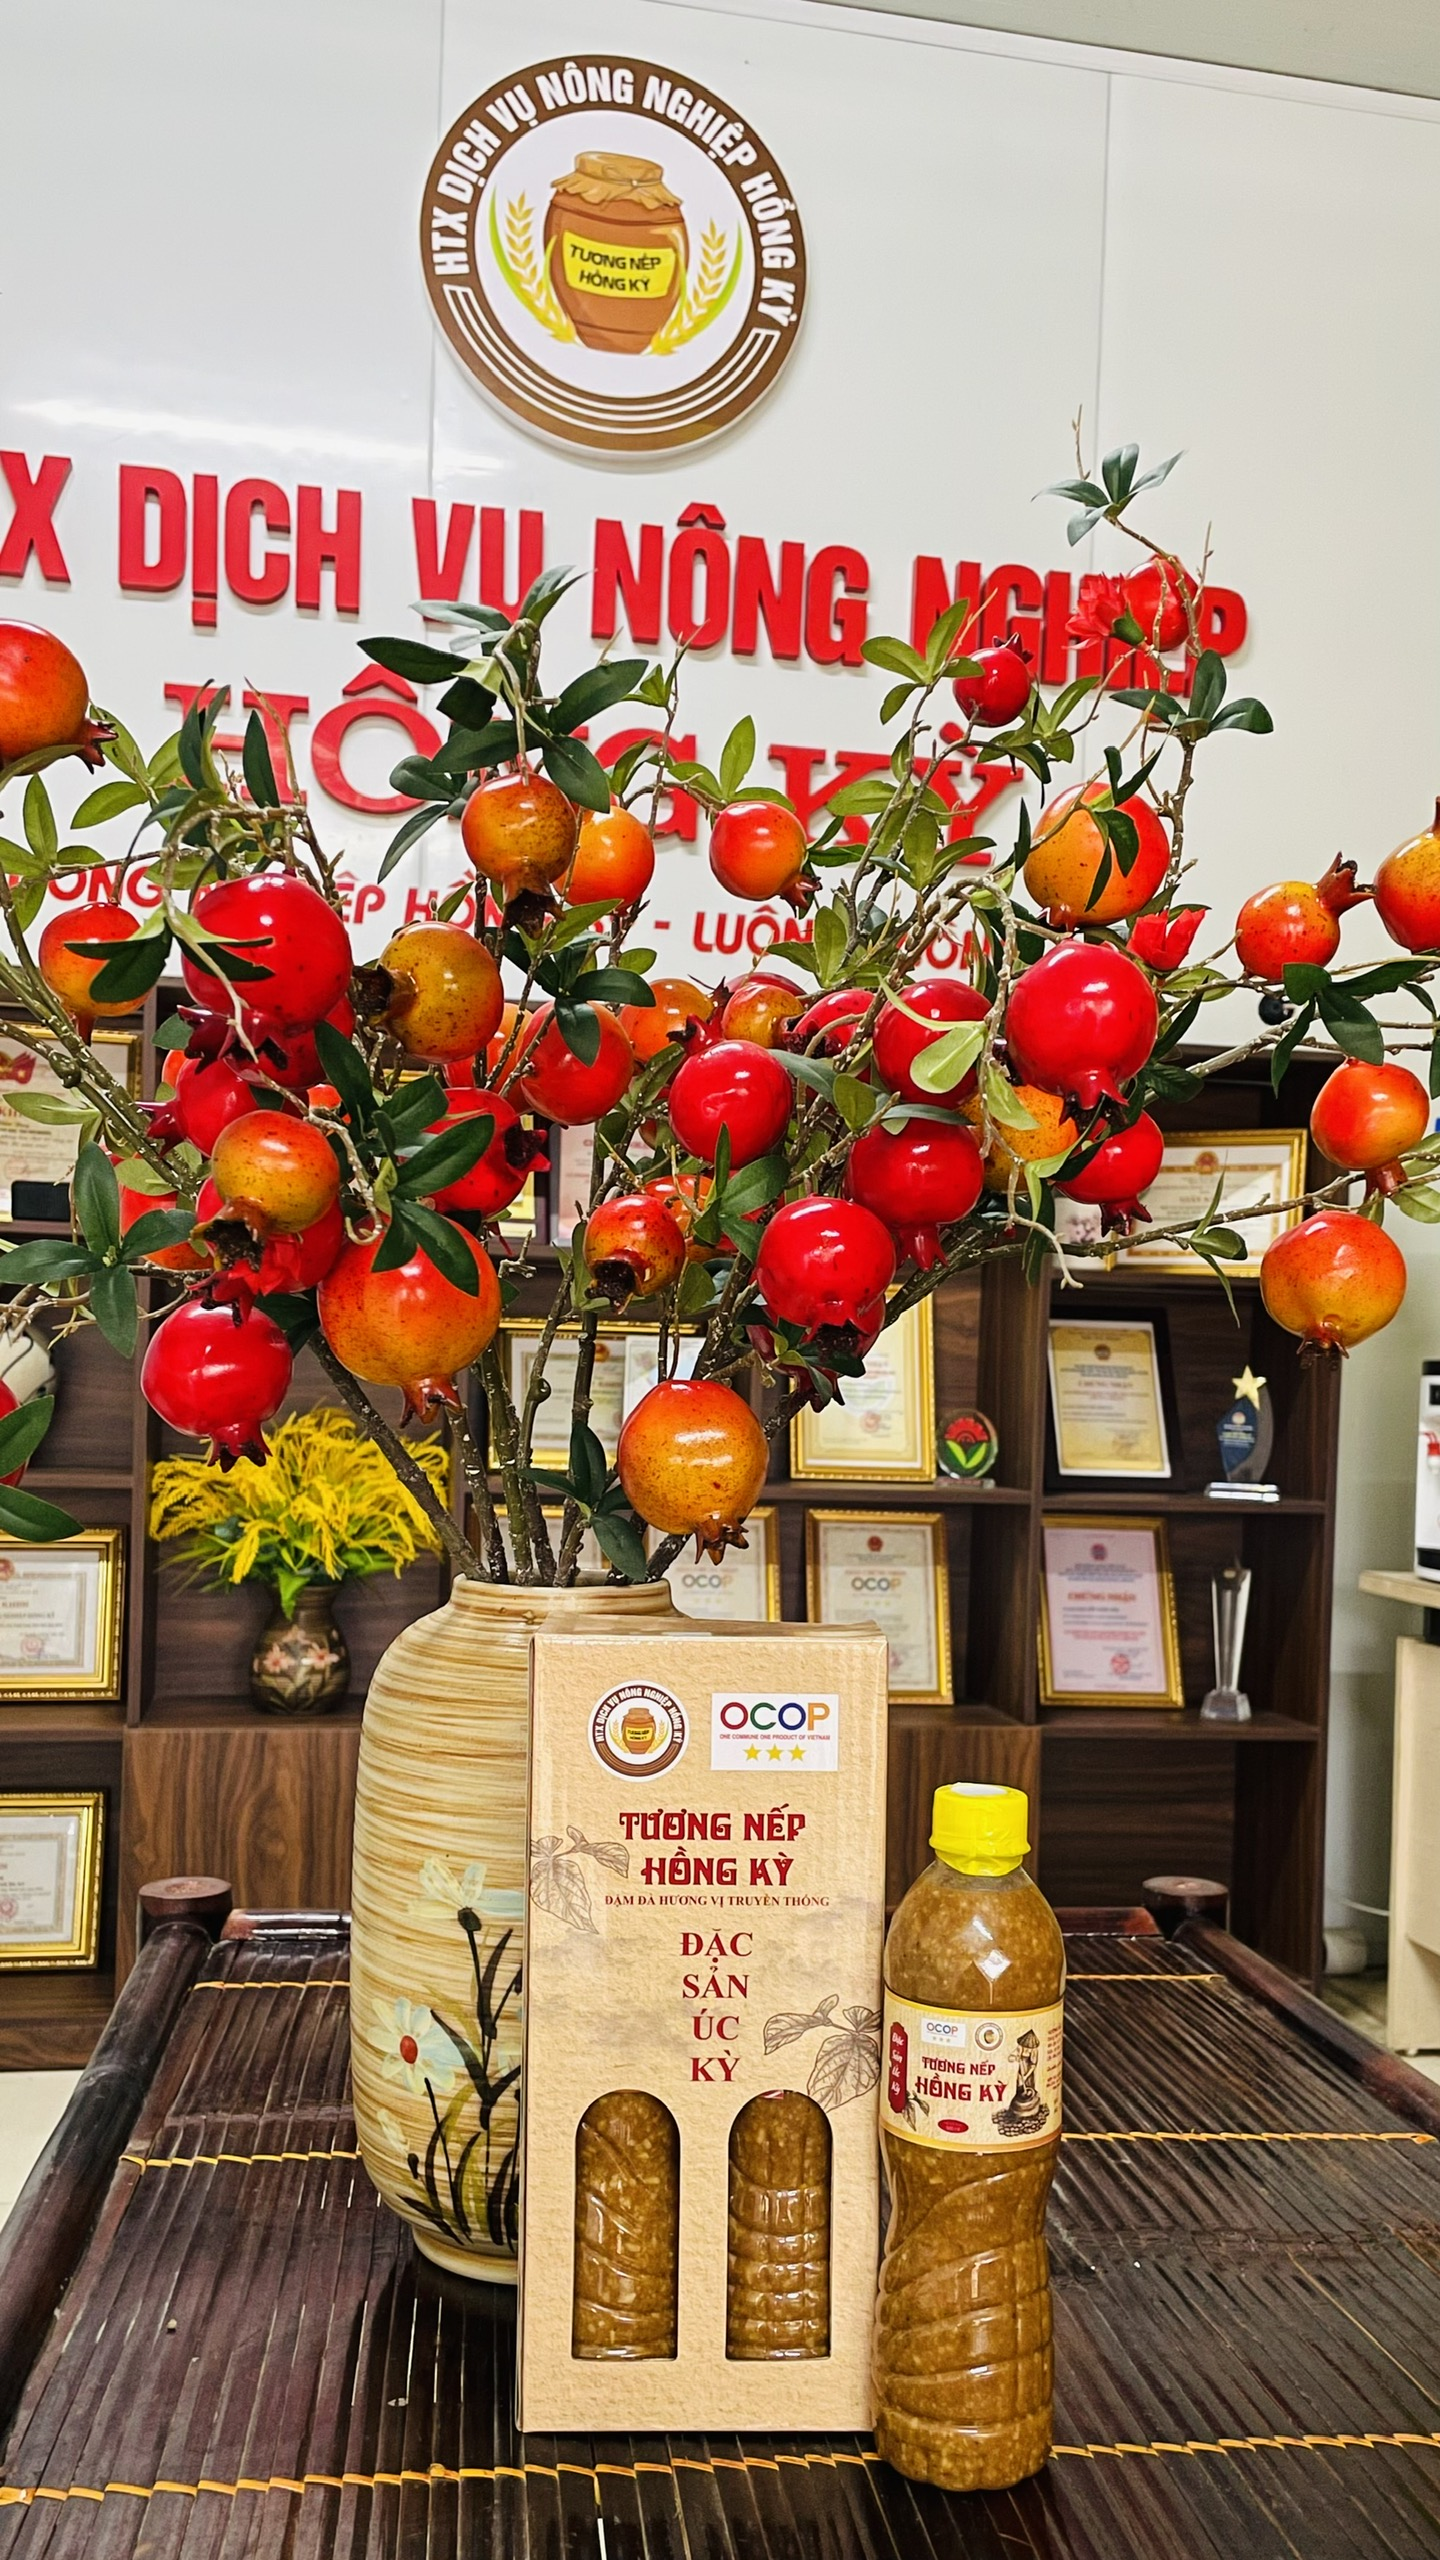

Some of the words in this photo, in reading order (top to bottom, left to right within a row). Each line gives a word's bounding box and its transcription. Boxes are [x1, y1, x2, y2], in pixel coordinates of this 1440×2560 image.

[535, 61, 634, 111] NÔNG
[486, 83, 539, 129] VỤ
[642, 75, 758, 169] NGHIỆP
[438, 119, 502, 203] DỊCH
[740, 171, 798, 271] HỒNG
[431, 206, 471, 276] HTX
[757, 277, 797, 327] KỲ
[119, 464, 361, 627] DỊCH
[592, 502, 870, 667] NÔNG
[720, 1702, 830, 1731] OCOP
[619, 1808, 731, 1841] TƯƠNG
[743, 1803, 806, 1841] NẾP
[640, 1846, 738, 1886] HỒNG
[749, 1852, 795, 1886] KỲ
[638, 1893, 656, 1906] ĐÀ
[659, 1894, 707, 1906] HƯƠNG
[710, 1895, 725, 1909] VỊ
[679, 1928, 753, 1963] ĐẶC
[682, 1966, 750, 1999] SẢN
[692, 2008, 740, 2041] ÚC
[926, 2022, 959, 2035] OCOP
[690, 2049, 741, 2082] KỲ
[921, 2056, 965, 2075] TƯƠNG
[970, 2059, 996, 2076] NẾP
[915, 2072, 971, 2101] HỒNG
[979, 2080, 1008, 2102] KỲ
